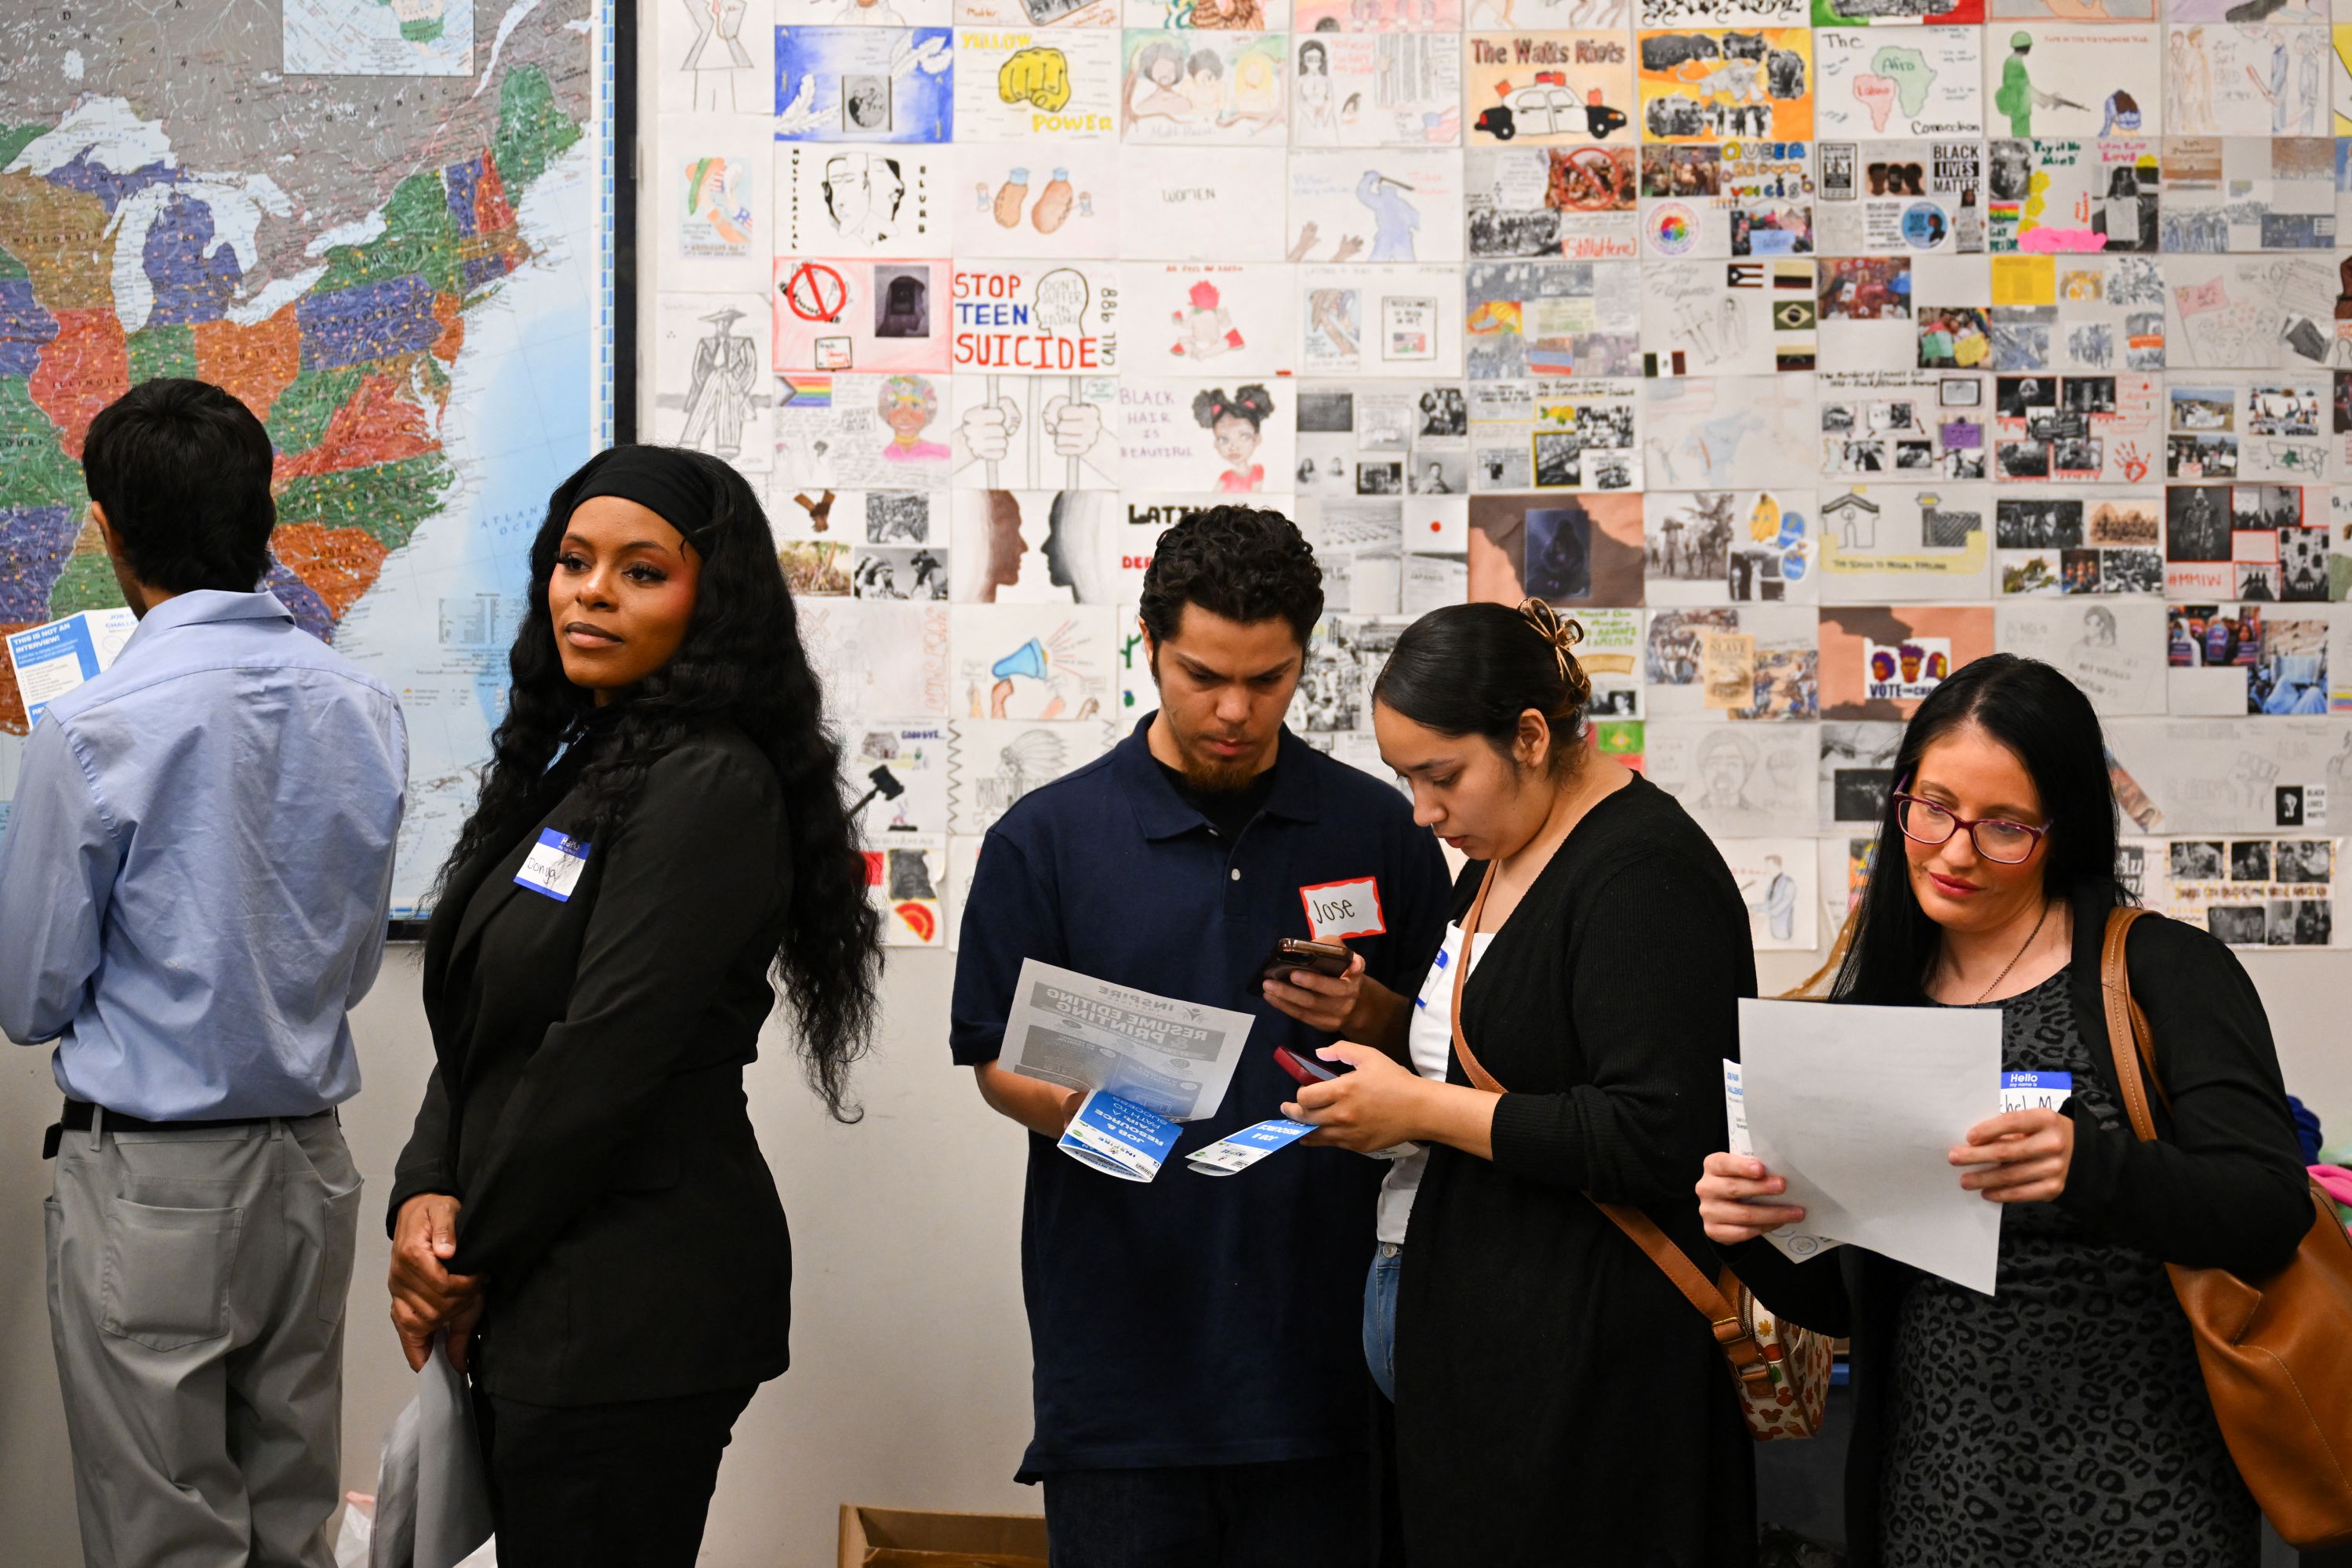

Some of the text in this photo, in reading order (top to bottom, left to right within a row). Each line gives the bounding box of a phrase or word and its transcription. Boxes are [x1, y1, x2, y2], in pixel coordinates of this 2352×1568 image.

[961, 33, 1033, 50] YELLOW
[1821, 33, 1864, 49] The
[1471, 39, 1508, 64] The
[1575, 39, 1626, 64] Riots
[1882, 56, 1916, 72] Afro
[1031, 114, 1113, 132] POWER
[1721, 142, 1807, 161] QUEER
[1933, 145, 1980, 158] BLACK
[1938, 161, 1975, 176] LIVES
[1162, 188, 1216, 203] WOMEN
[1933, 179, 1981, 194] MATTER
[953, 273, 1022, 298] STOP
[956, 303, 1028, 325] TEEN
[1101, 288, 1117, 366] CALL 988
[954, 333, 1098, 369] SUICIDE
[1120, 387, 1174, 405] BLACK
[1127, 412, 1171, 424] HAIR
[1143, 429, 1160, 440] IS
[1120, 446, 1194, 459] BEAUTIFUL
[13, 636, 32, 646] THIS
[42, 629, 58, 637] NOT
[59, 623, 71, 632] AN
[16, 636, 60, 653] INTERVIEW!
[1870, 684, 1901, 697] VOTE
[527, 858, 556, 884] Donya
[1312, 899, 1355, 924] Jose
[2010, 1073, 2038, 1083] Hello
[1112, 1096, 1167, 1125] SUCCESS
[1113, 1102, 1160, 1130] PATH TO
[1094, 1109, 1164, 1146] RESOURCE
[1106, 1123, 1145, 1144] JOB &
[1123, 1115, 1155, 1134] FAIR:
[1098, 1137, 1136, 1158] INSPIRE
